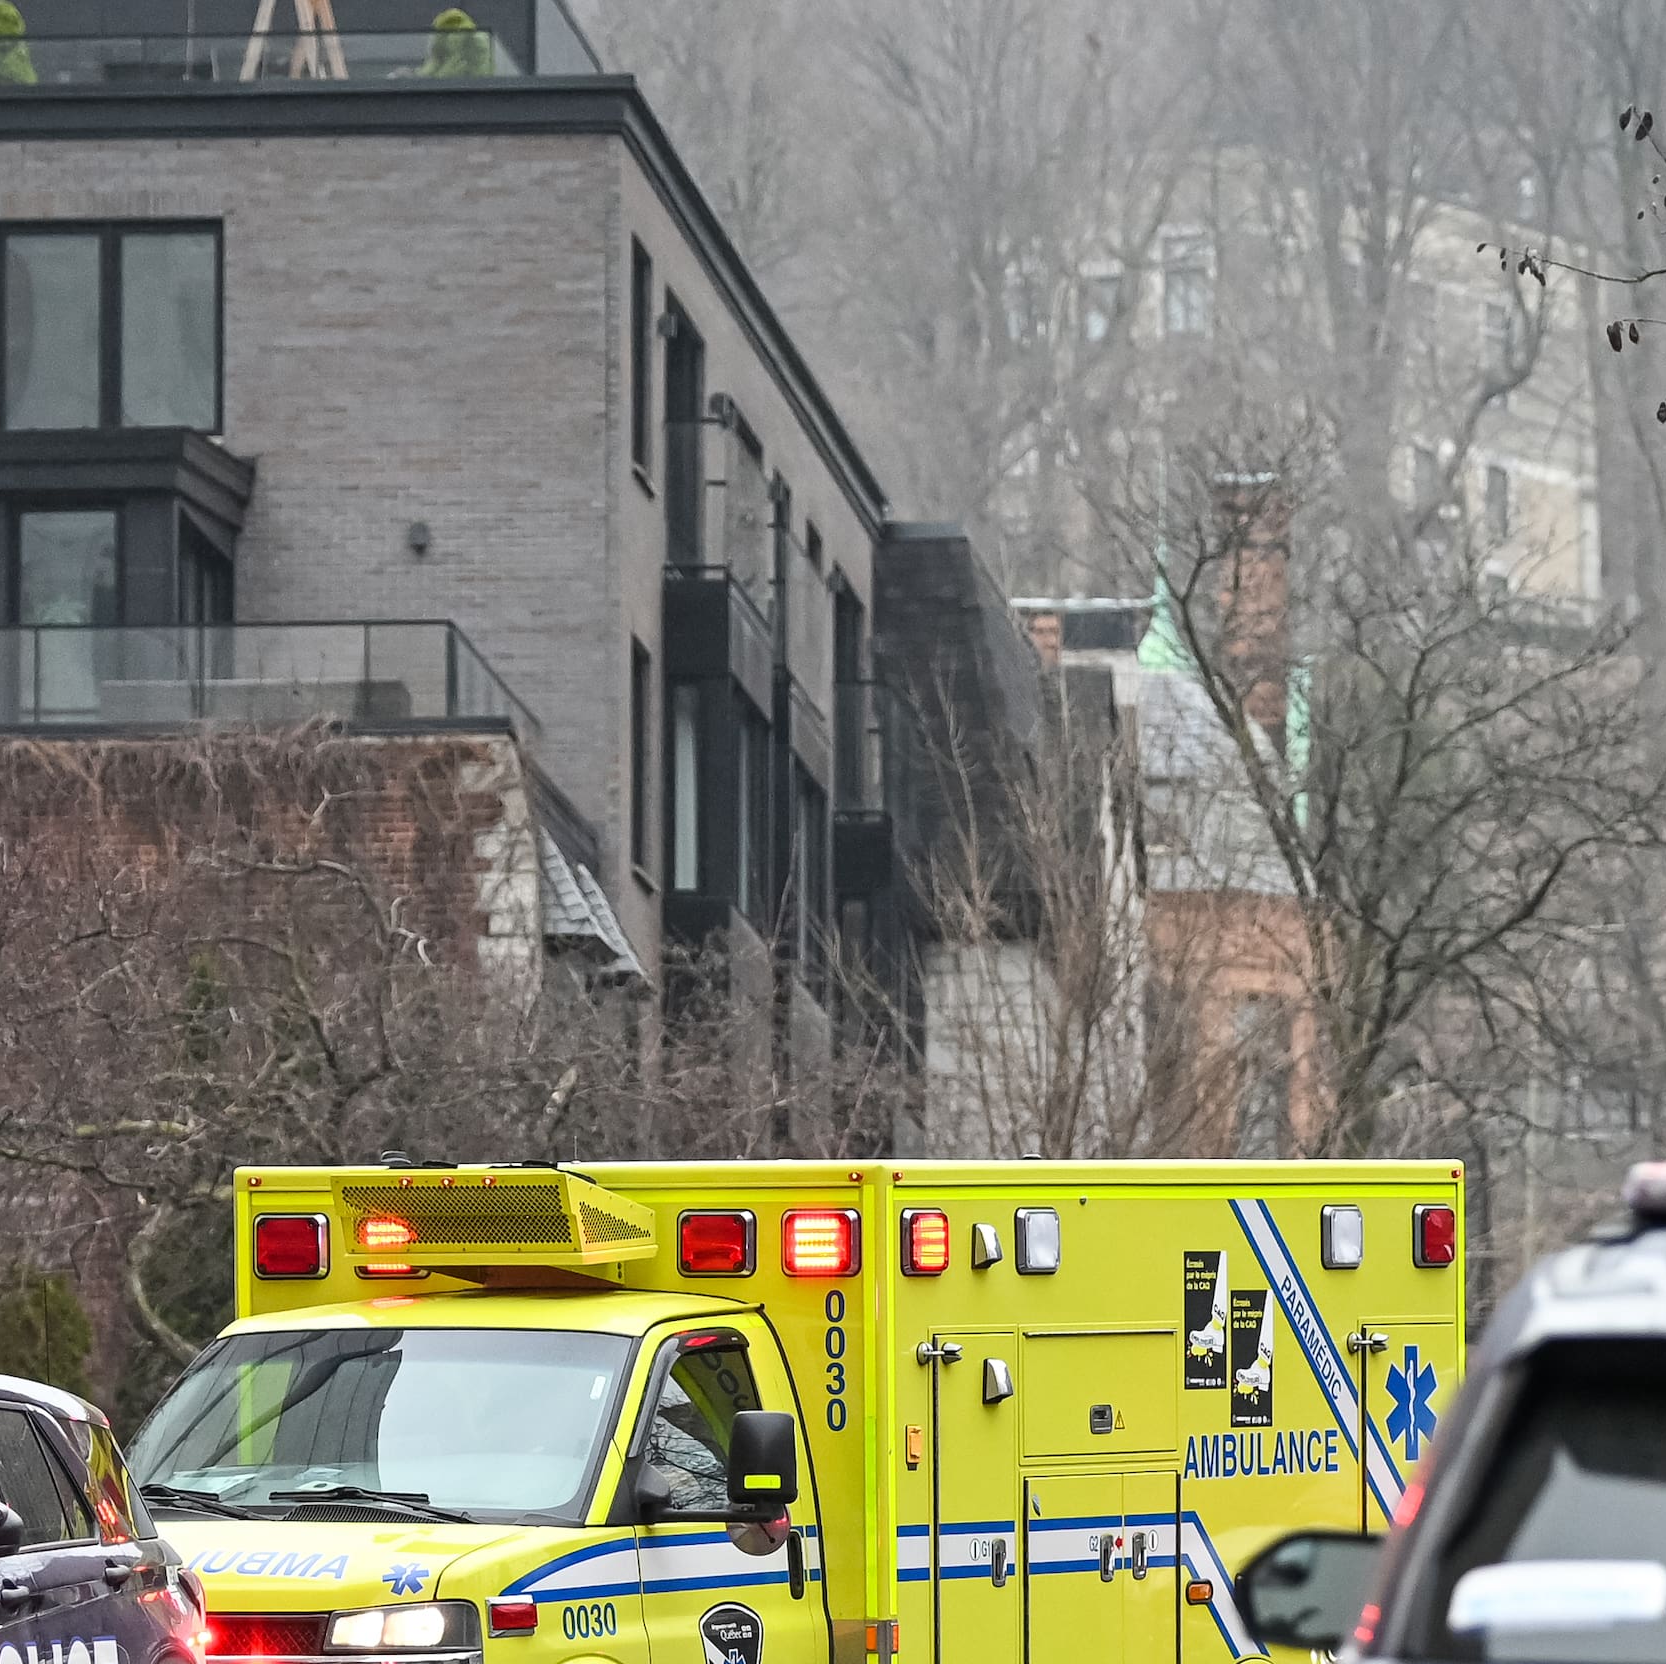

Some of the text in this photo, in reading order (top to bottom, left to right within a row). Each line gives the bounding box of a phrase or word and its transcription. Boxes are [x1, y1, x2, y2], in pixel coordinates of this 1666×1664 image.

[1281, 1275, 1342, 1400] PARAMÉDIC
[825, 1290, 847, 1431] 0030
[1183, 1430, 1339, 1479] AMBULANCE
[981, 1540, 991, 1557] G1
[1089, 1536, 1099, 1551] G2
[563, 1602, 616, 1640] 0030
